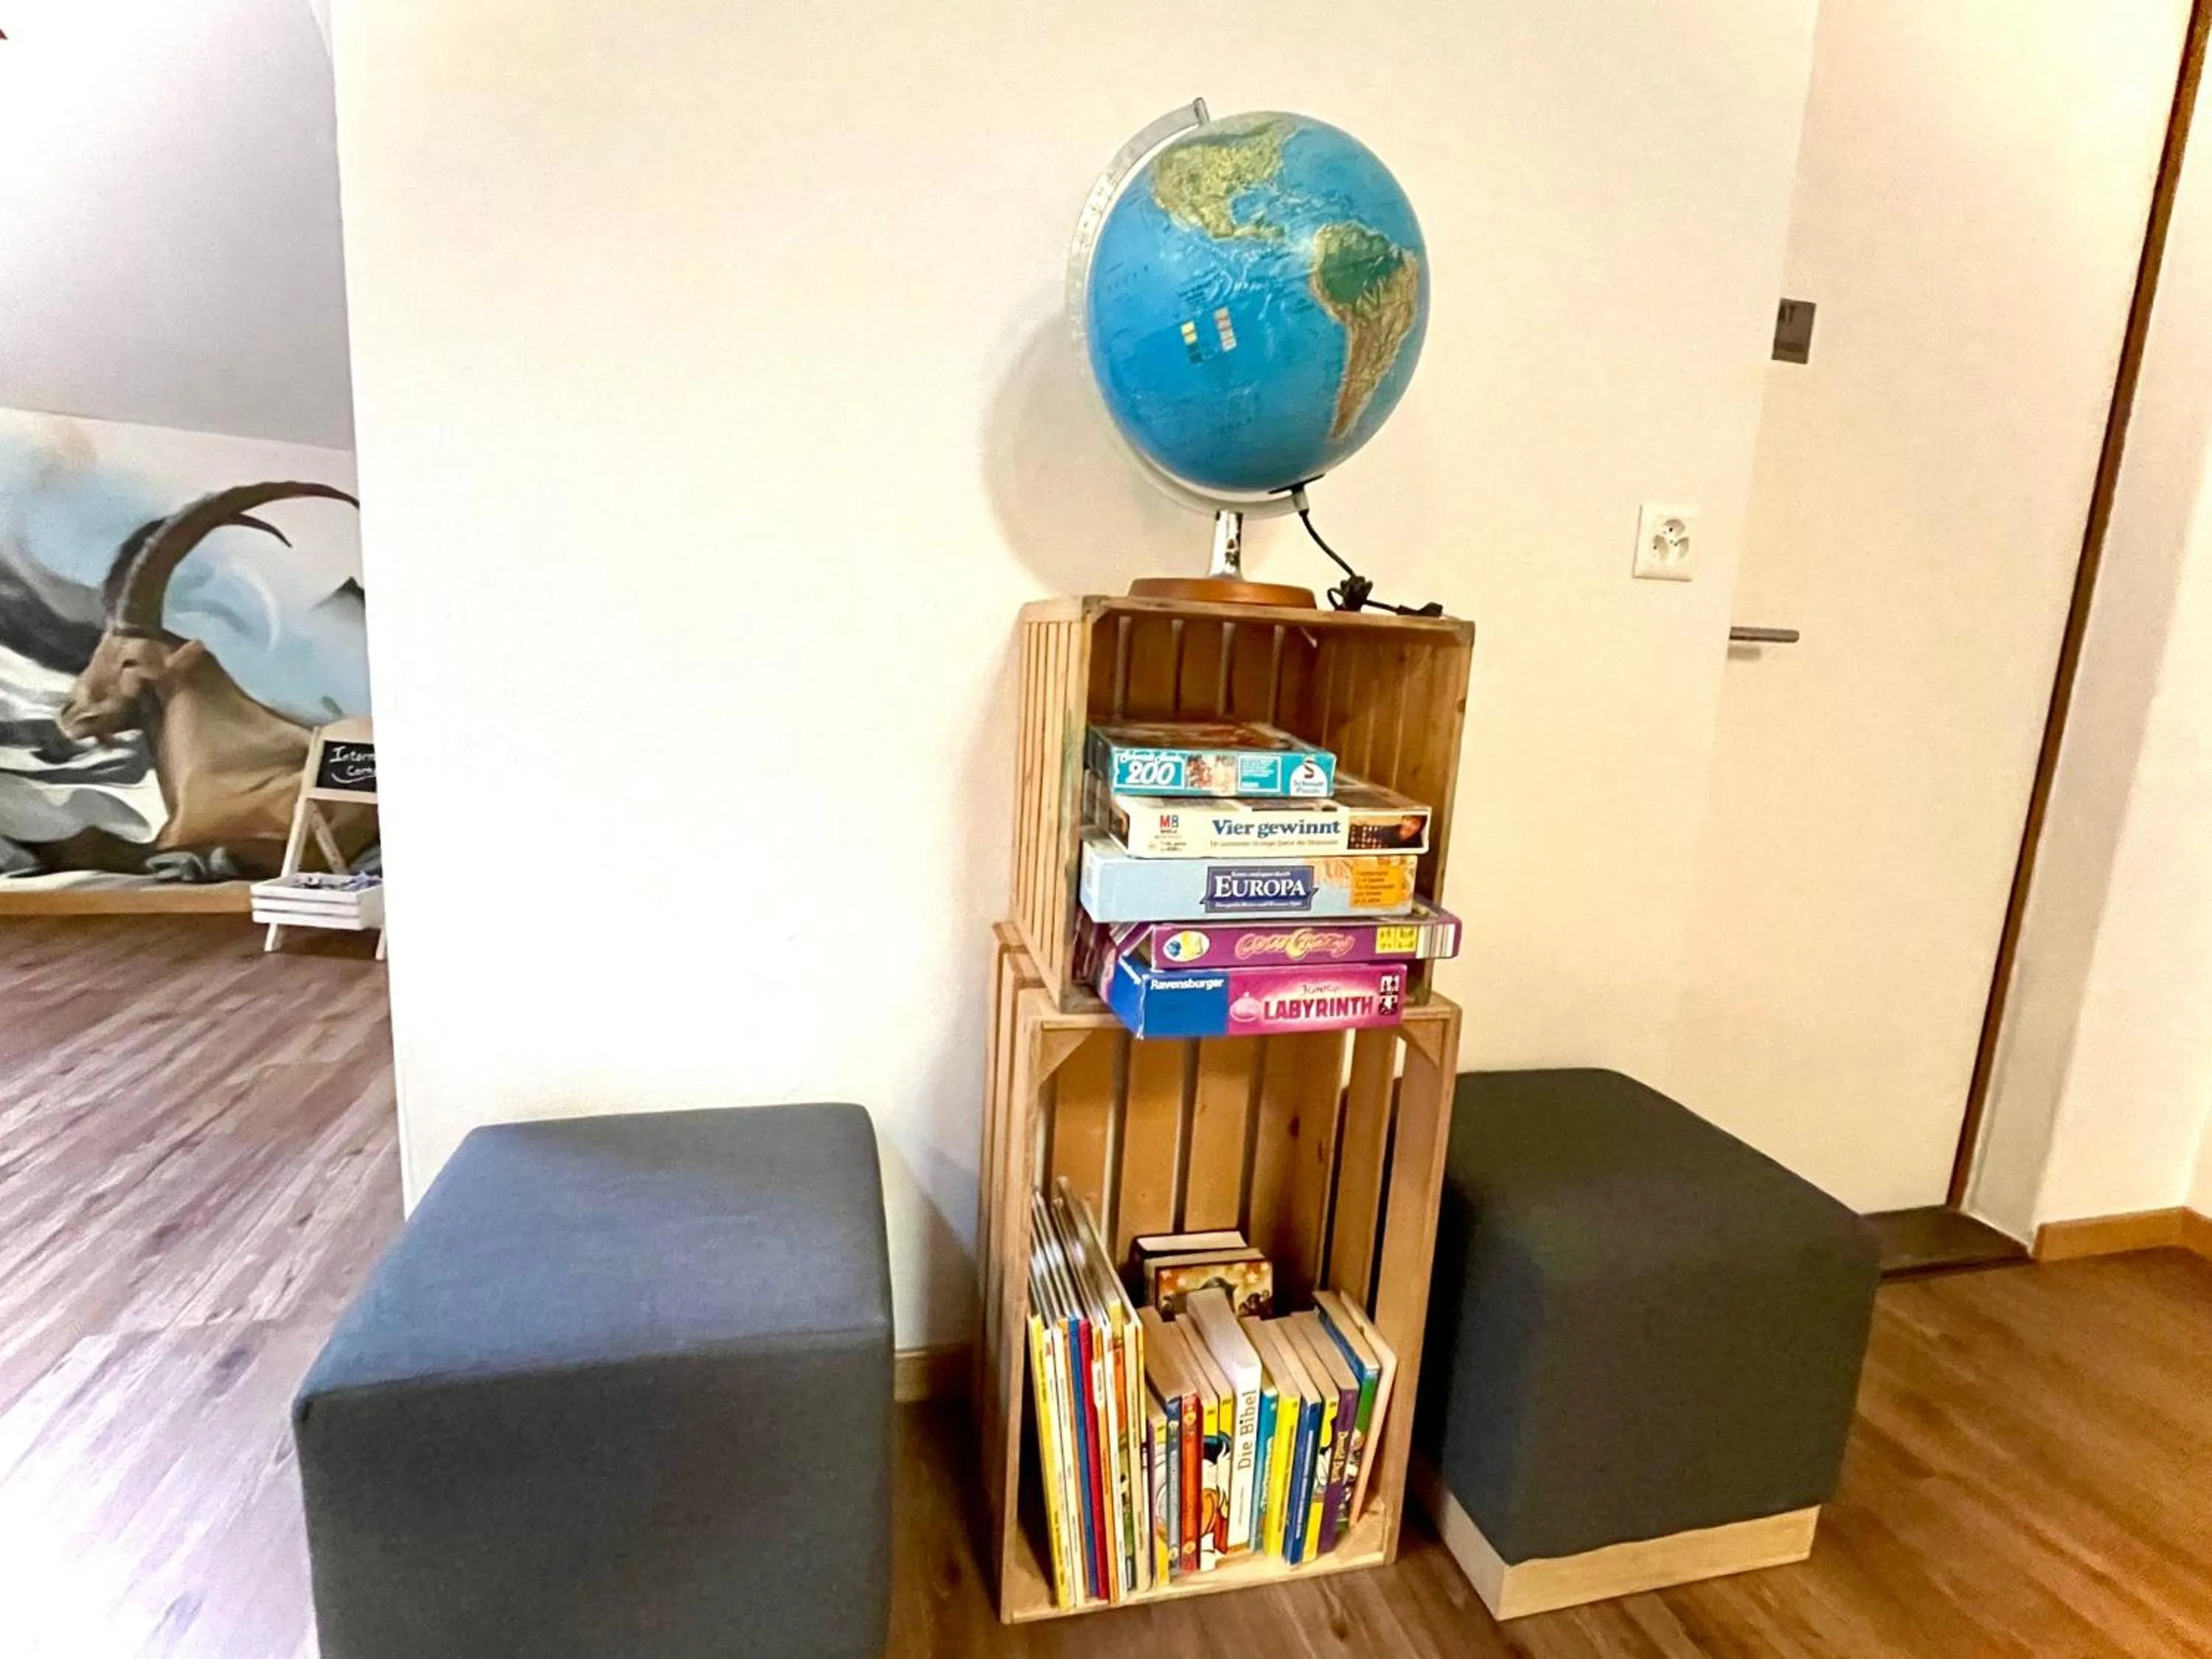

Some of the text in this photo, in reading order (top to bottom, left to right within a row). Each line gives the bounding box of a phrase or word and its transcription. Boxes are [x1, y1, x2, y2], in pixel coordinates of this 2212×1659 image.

[1126, 762, 1175, 785] 200
[1160, 814, 1179, 828] MB
[1212, 819, 1341, 838] Vier gewinnt
[1214, 875, 1306, 897] EUROPA
[1150, 978, 1224, 990] Ravensburger
[1264, 996, 1374, 1020] LABYRINTH
[1239, 1391, 1258, 1435] Bibel
[1237, 1441, 1253, 1471] Die
